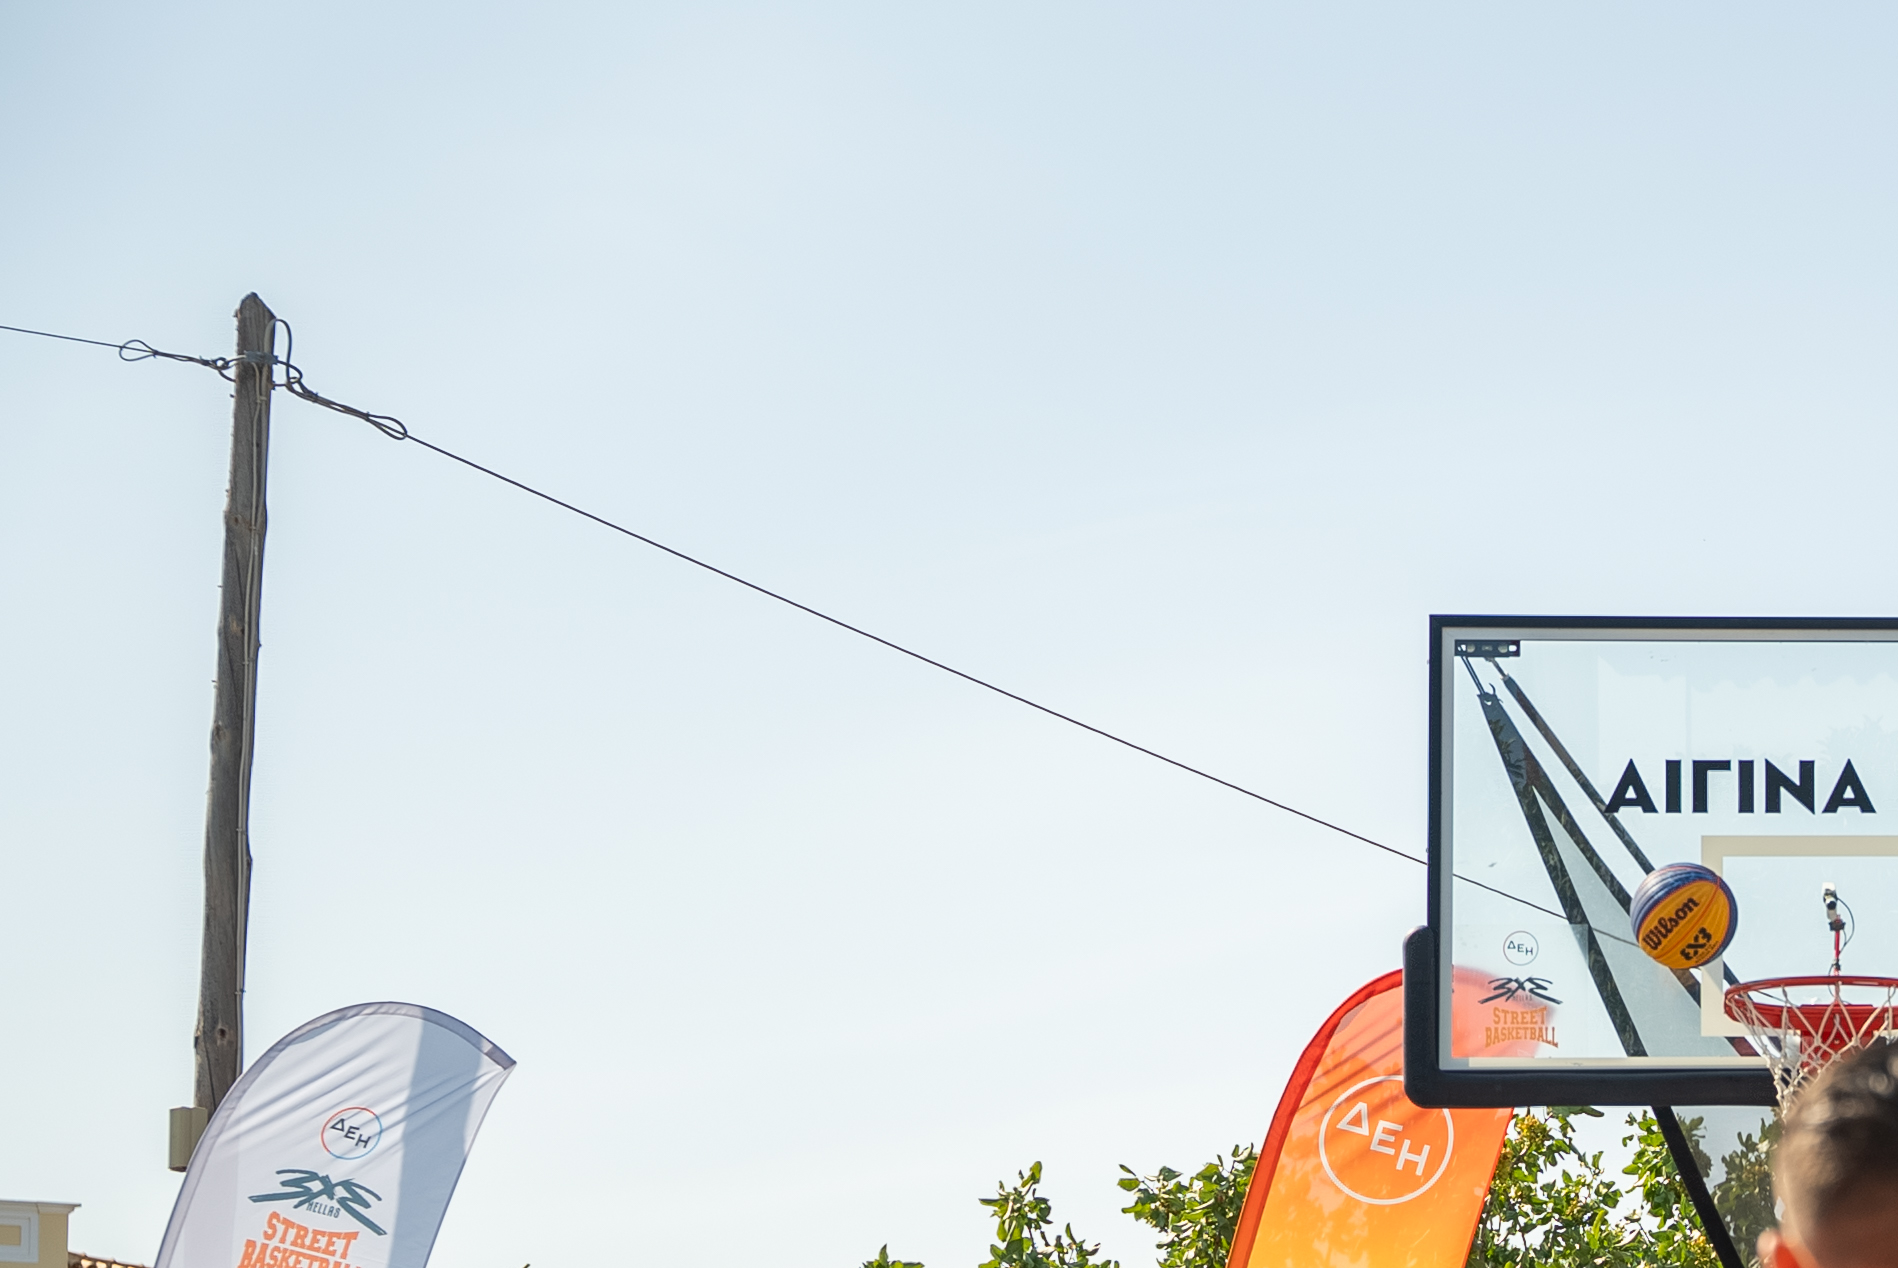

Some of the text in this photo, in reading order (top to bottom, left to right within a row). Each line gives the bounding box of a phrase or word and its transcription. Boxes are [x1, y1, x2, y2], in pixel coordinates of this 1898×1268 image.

[1604, 758, 1876, 815] ΑΙΓΙΝΑ
[1642, 897, 1700, 950] Wilson
[1507, 940, 1533, 956] ΔΕΗ
[1493, 1005, 1547, 1025] STREET
[1485, 1026, 1558, 1048] BASKETBALL
[330, 1118, 371, 1148] ΔΕΗ
[1336, 1101, 1430, 1176] ΔΕΗ
[263, 1211, 360, 1260] STREET
